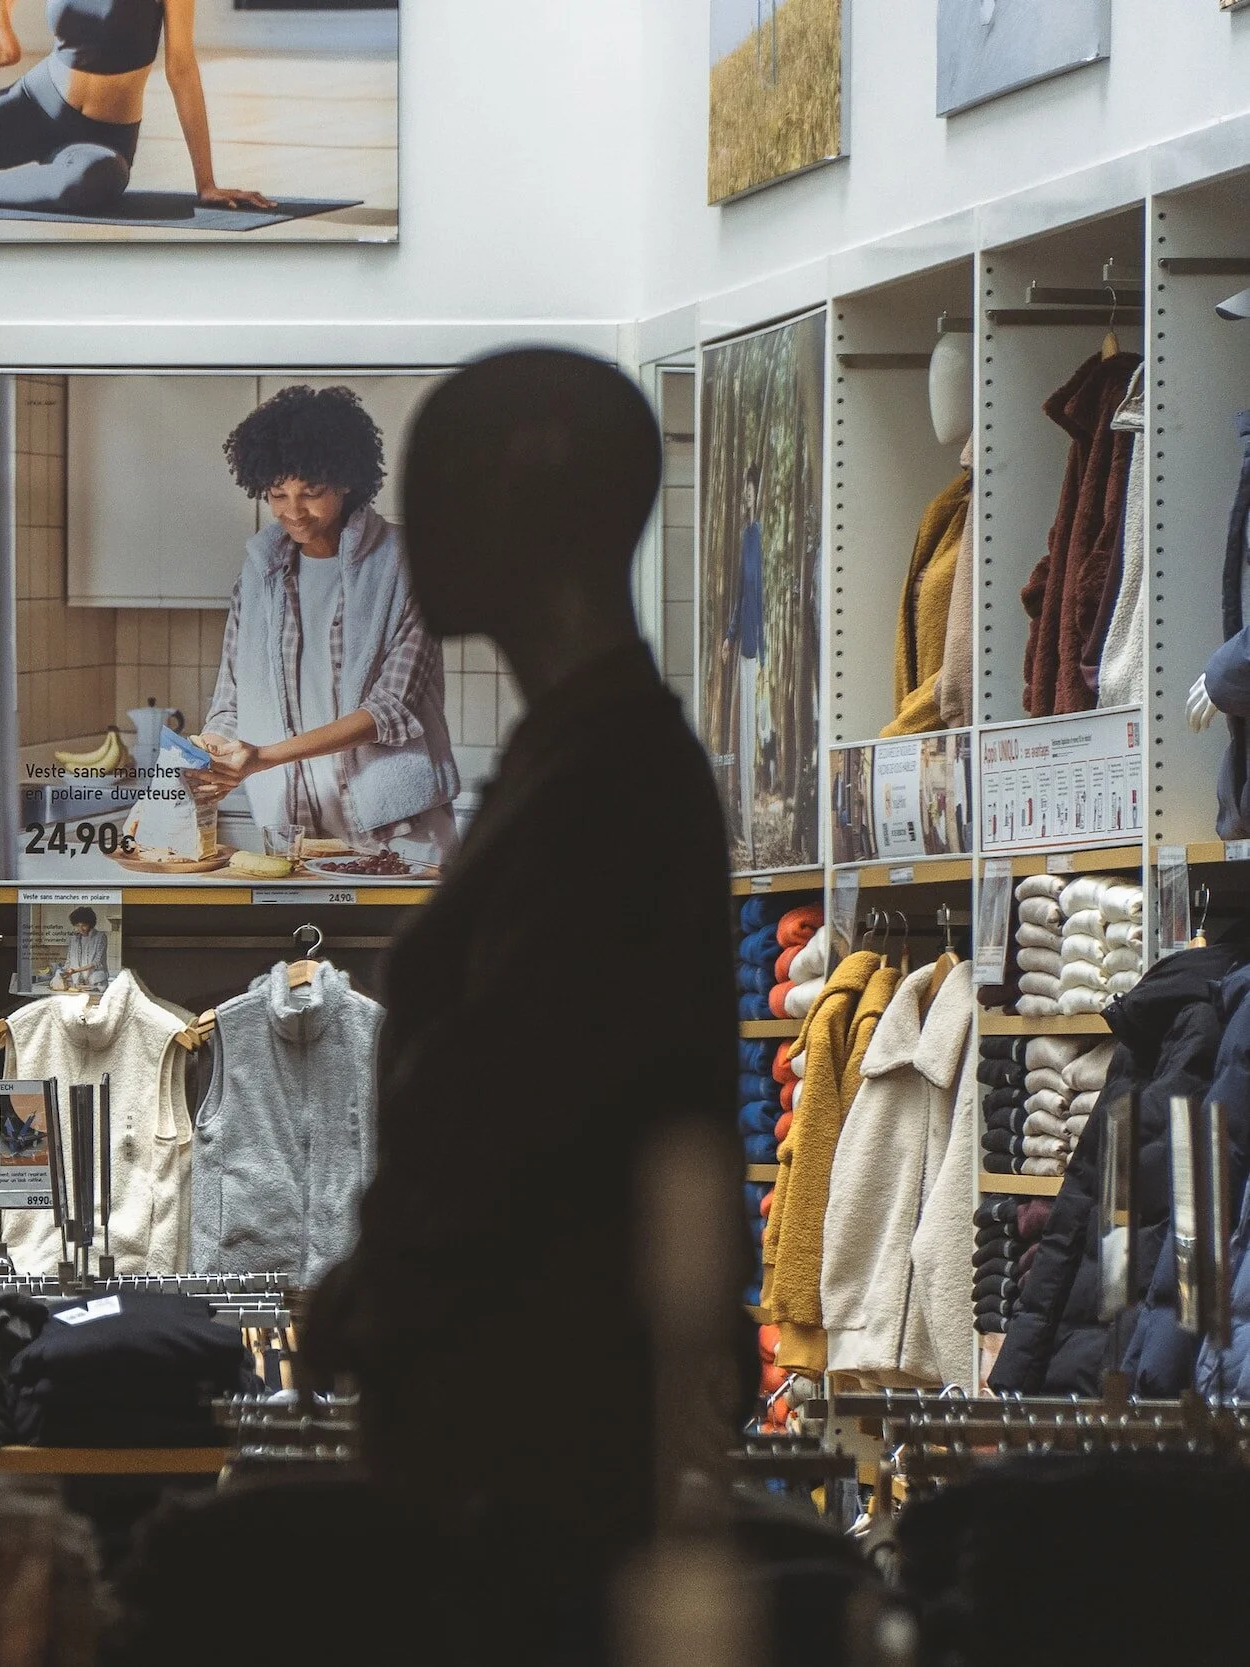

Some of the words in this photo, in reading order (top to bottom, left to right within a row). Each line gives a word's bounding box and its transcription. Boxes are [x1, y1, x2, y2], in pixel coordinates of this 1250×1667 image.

[26, 764, 66, 778] Veste
[73, 767, 106, 778] sans
[114, 764, 181, 778] manches
[26, 789, 43, 800] en
[51, 786, 103, 804] polaire
[111, 786, 186, 801] duveteuse
[25, 822, 136, 858] 24,90€
[91, 893, 110, 901] polaire
